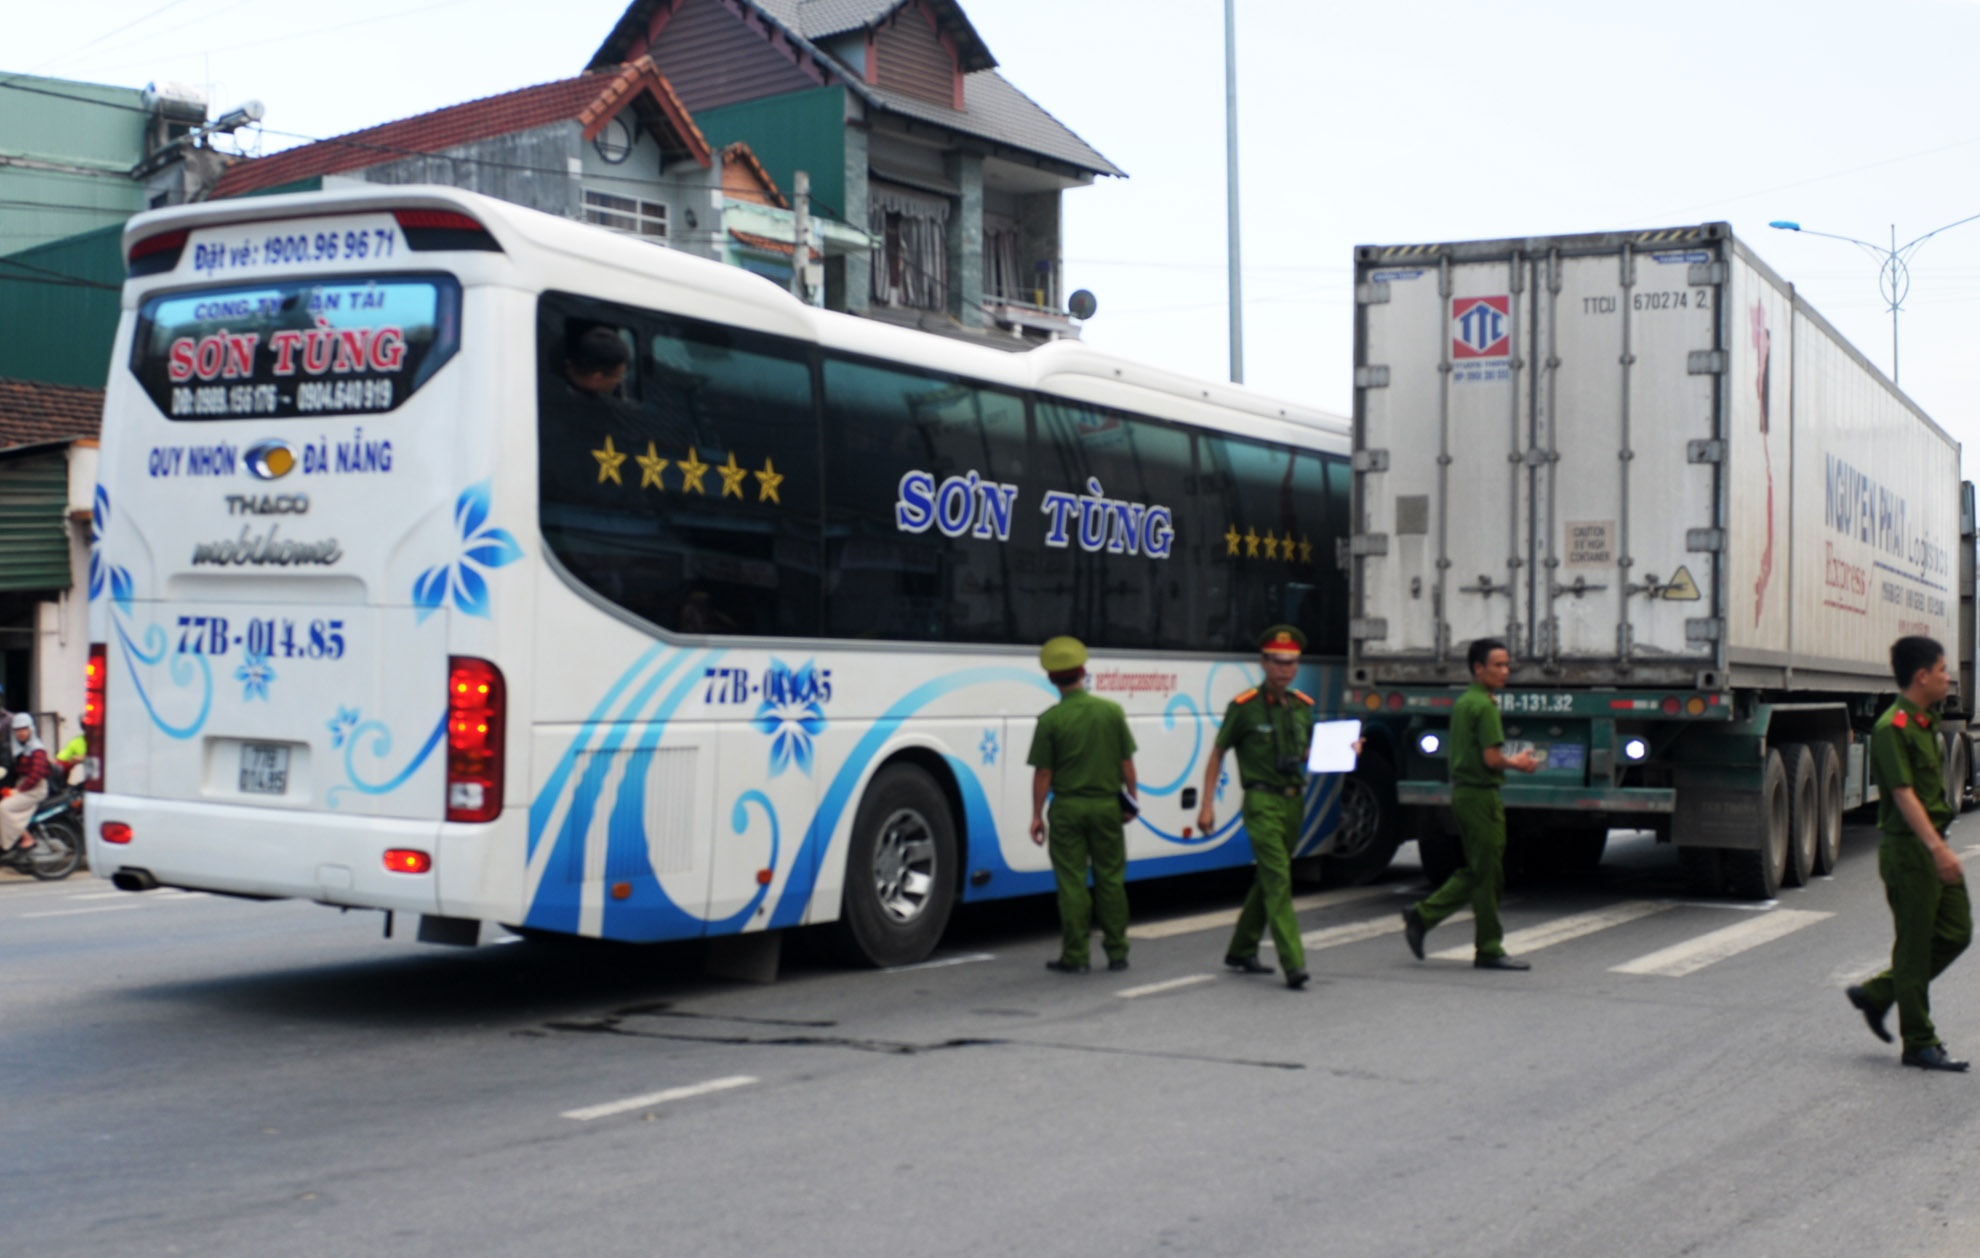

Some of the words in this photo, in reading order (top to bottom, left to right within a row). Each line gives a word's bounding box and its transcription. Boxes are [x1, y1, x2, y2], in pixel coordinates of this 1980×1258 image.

[194, 243, 224, 277] Đặt
[263, 234, 337, 264] 1900.96
[344, 231, 369, 260] 96
[374, 228, 395, 257] 71
[1583, 296, 1615, 314] TTCU
[1633, 291, 1688, 312] 670274
[168, 328, 258, 382] SƠN
[269, 317, 406, 375] TÙNG
[149, 446, 184, 477] QUY
[303, 434, 328, 473] ĐÀ
[225, 493, 309, 515] THACO
[895, 469, 1018, 542] SƠN
[1041, 476, 1175, 558] TÙNG
[192, 523, 344, 566] mobihome
